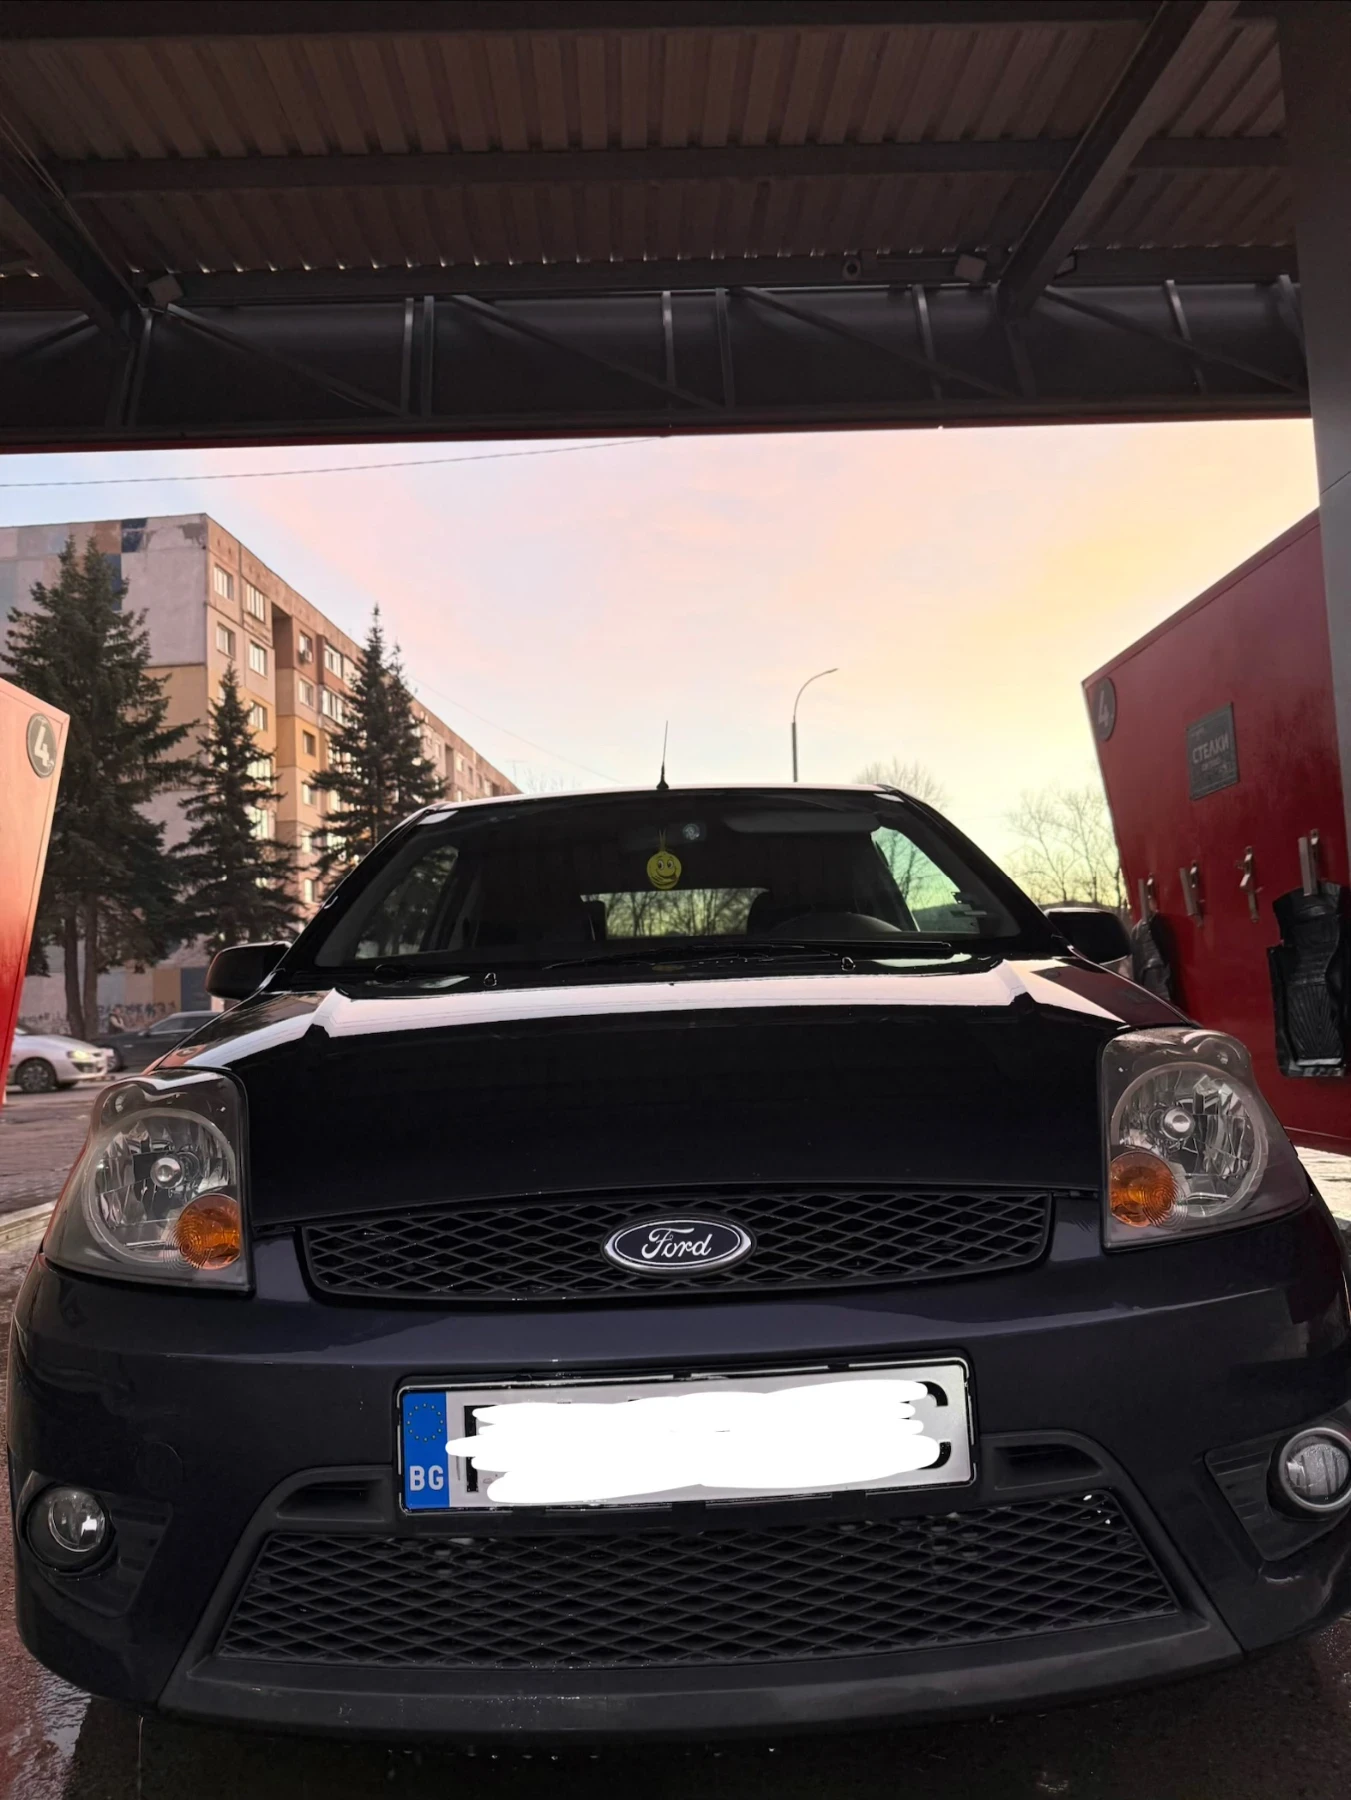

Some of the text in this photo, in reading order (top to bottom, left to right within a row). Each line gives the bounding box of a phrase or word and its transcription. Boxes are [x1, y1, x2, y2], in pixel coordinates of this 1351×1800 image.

[1098, 690, 1109, 727] 4
[34, 726, 49, 767] 4
[1192, 733, 1229, 764] СТЕЛКИ
[641, 1227, 712, 1259] Ford
[409, 1465, 444, 1491] BG
